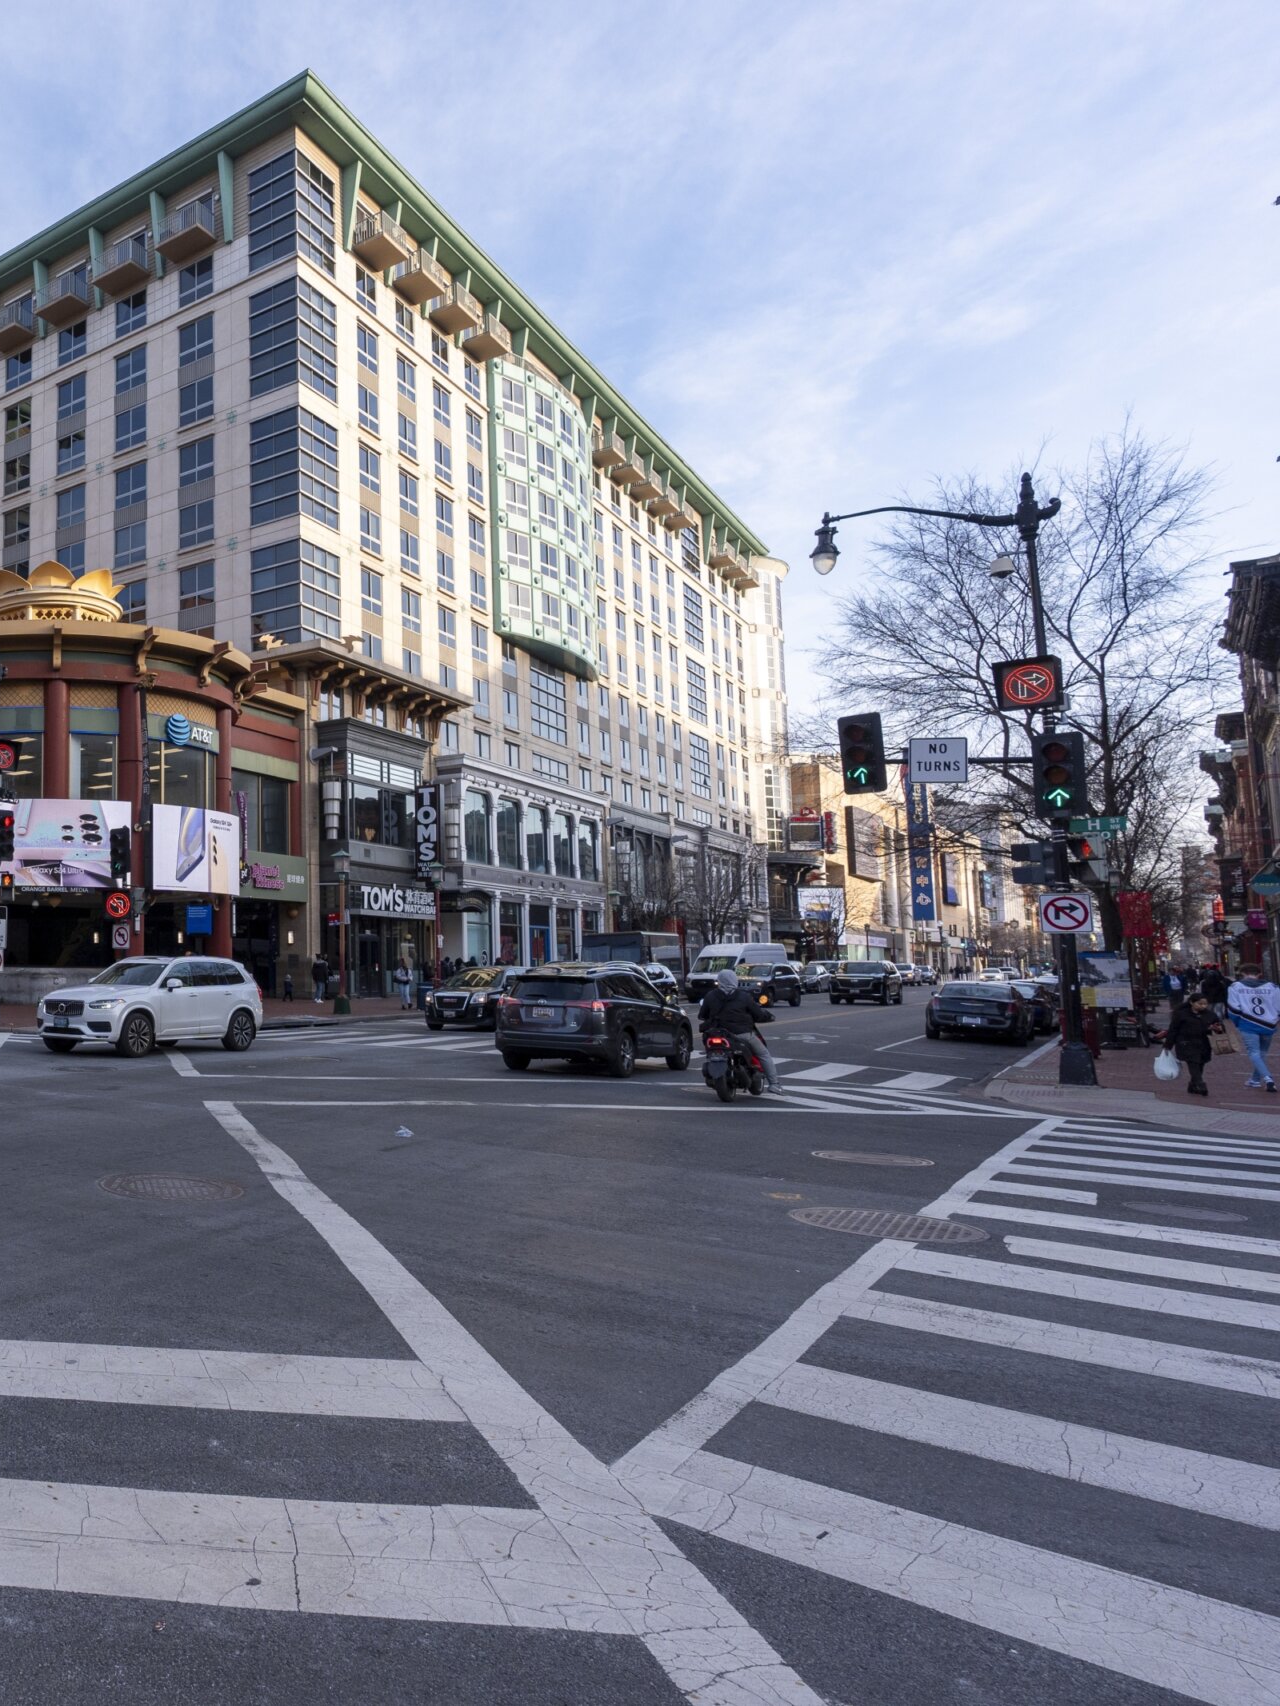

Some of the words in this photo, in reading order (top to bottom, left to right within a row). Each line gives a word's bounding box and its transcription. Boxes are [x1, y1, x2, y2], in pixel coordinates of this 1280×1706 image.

[191, 726, 214, 744] AT&T
[928, 743, 948, 754] NO
[916, 760, 961, 772] TURNS
[912, 783, 924, 824] Capita
[416, 787, 437, 862] TOMS
[1087, 818, 1100, 831] H
[26, 866, 53, 875] Galaxy
[54, 866, 67, 874] S24
[360, 883, 404, 913] TOM'S
[404, 904, 426, 914] WATCH
[1251, 996, 1265, 1016] 8
